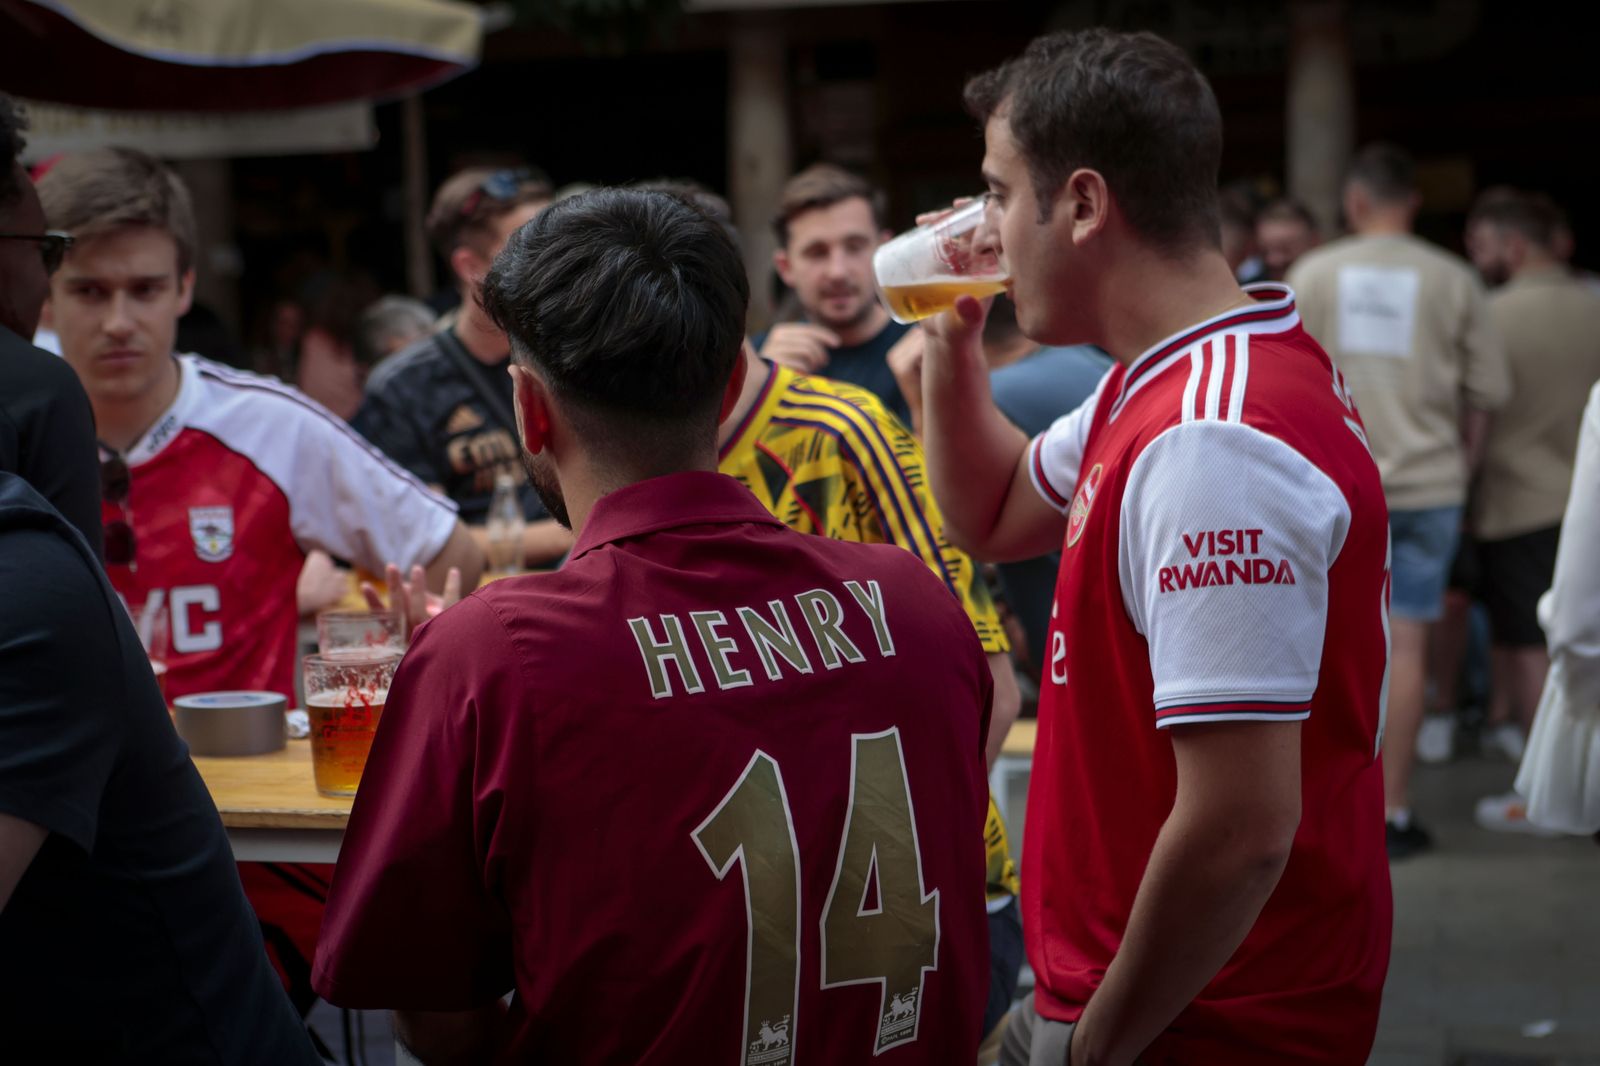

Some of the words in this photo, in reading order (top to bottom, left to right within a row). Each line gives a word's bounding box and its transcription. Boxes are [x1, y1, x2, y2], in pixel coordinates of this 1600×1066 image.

[1159, 559, 1295, 593] RWANDA
[1182, 529, 1263, 558] VISIT
[628, 580, 896, 699] HENRY
[690, 726, 940, 1066] 14
